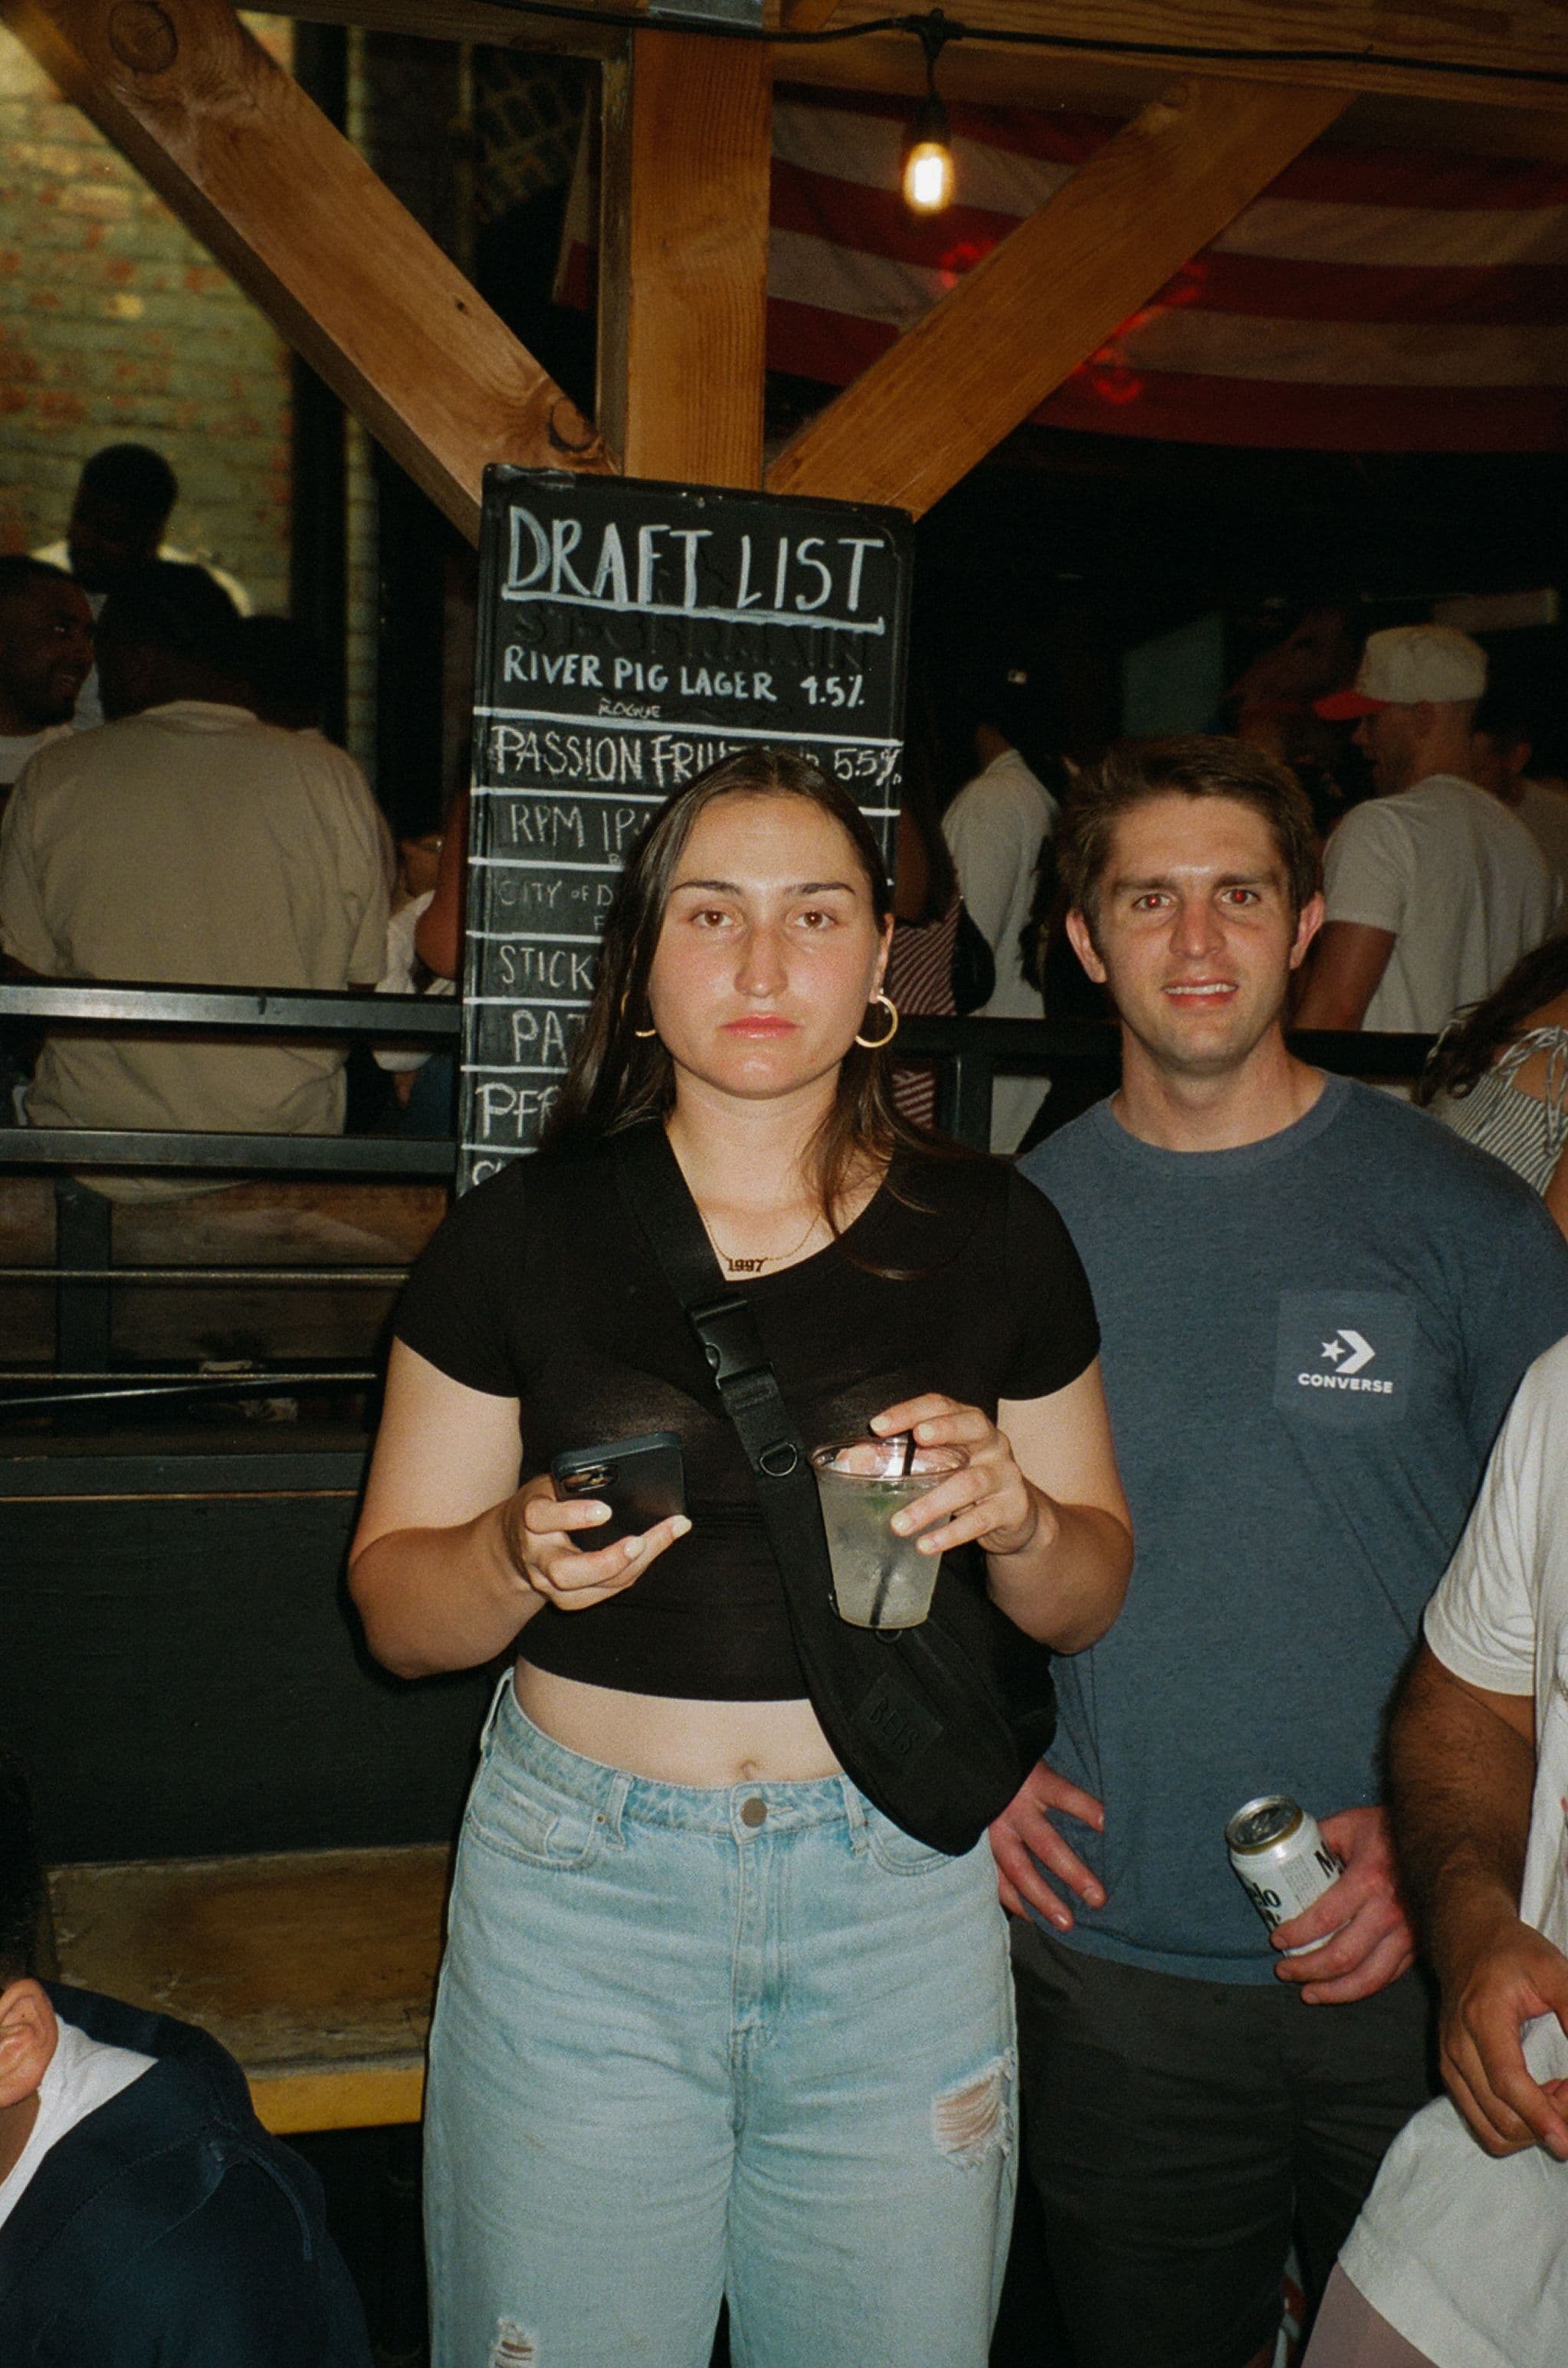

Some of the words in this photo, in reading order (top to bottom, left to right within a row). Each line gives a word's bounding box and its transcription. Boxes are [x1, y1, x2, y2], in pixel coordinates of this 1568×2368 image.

[507, 505, 713, 607] DRAFT
[736, 536, 884, 612] LIST
[504, 644, 603, 687] RIVER
[614, 656, 669, 691] PIG
[680, 665, 777, 702] LAGER
[598, 697, 661, 719] ROGUE
[490, 725, 643, 784] PASSION
[651, 734, 748, 789] FRU
[510, 804, 586, 848] RPM
[500, 880, 563, 909] CITY
[727, 1258, 766, 1273] 1997
[1297, 1373, 1394, 1394] CONVERSE
